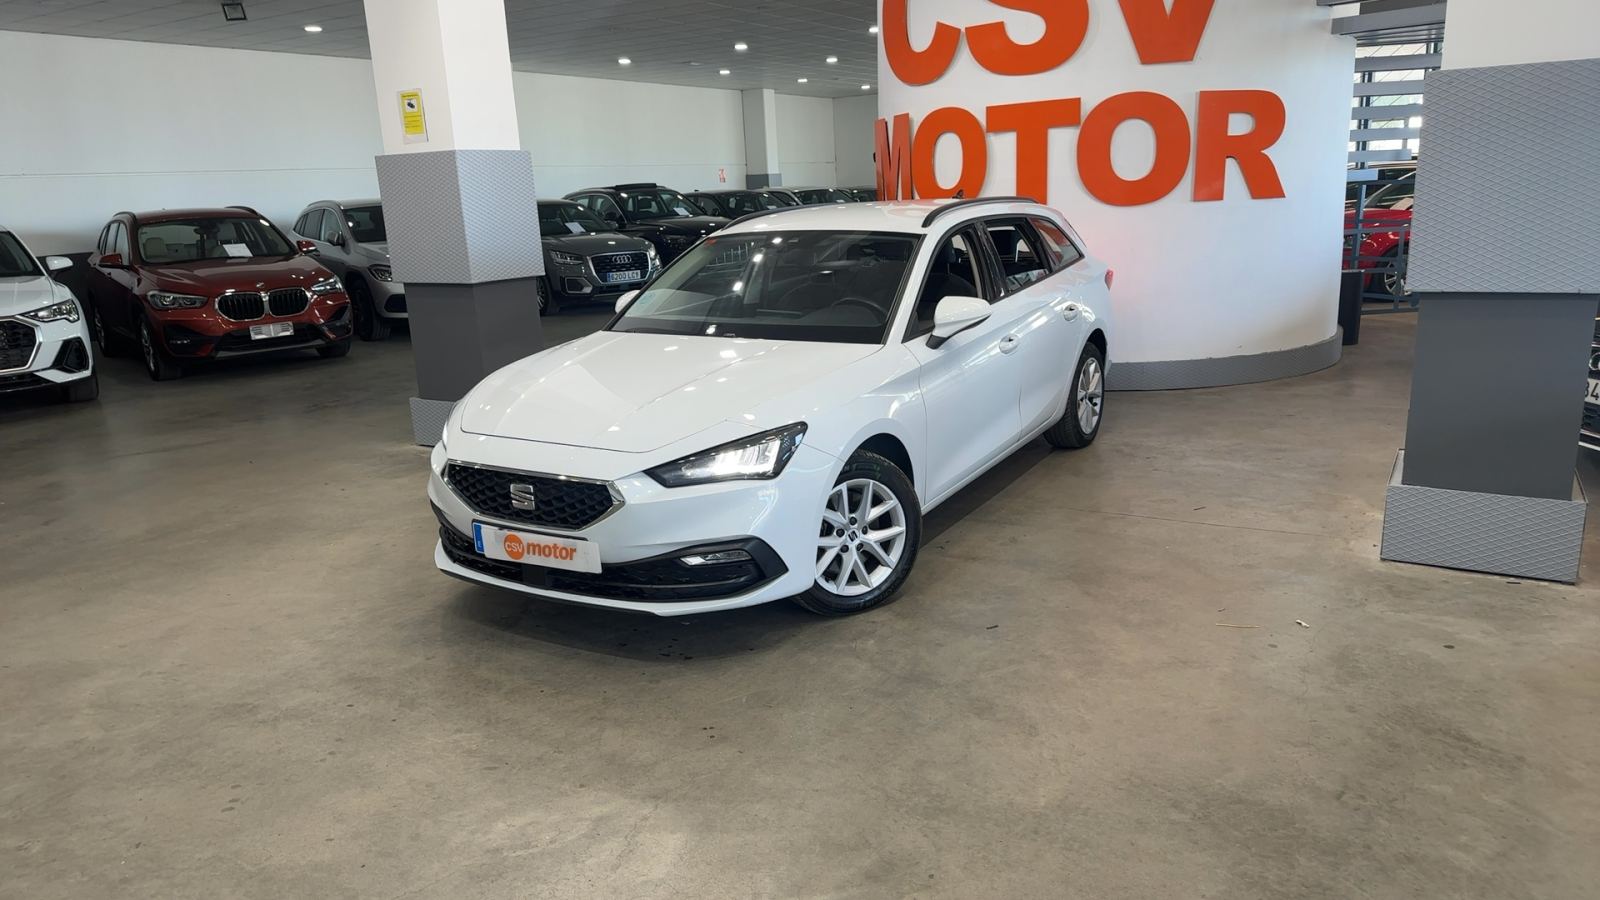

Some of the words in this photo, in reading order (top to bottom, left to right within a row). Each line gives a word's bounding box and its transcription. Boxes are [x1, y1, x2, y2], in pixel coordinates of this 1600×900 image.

[874, 90, 1287, 208] MOTOR
[504, 541, 523, 553] CSV
[526, 541, 577, 561] motor
